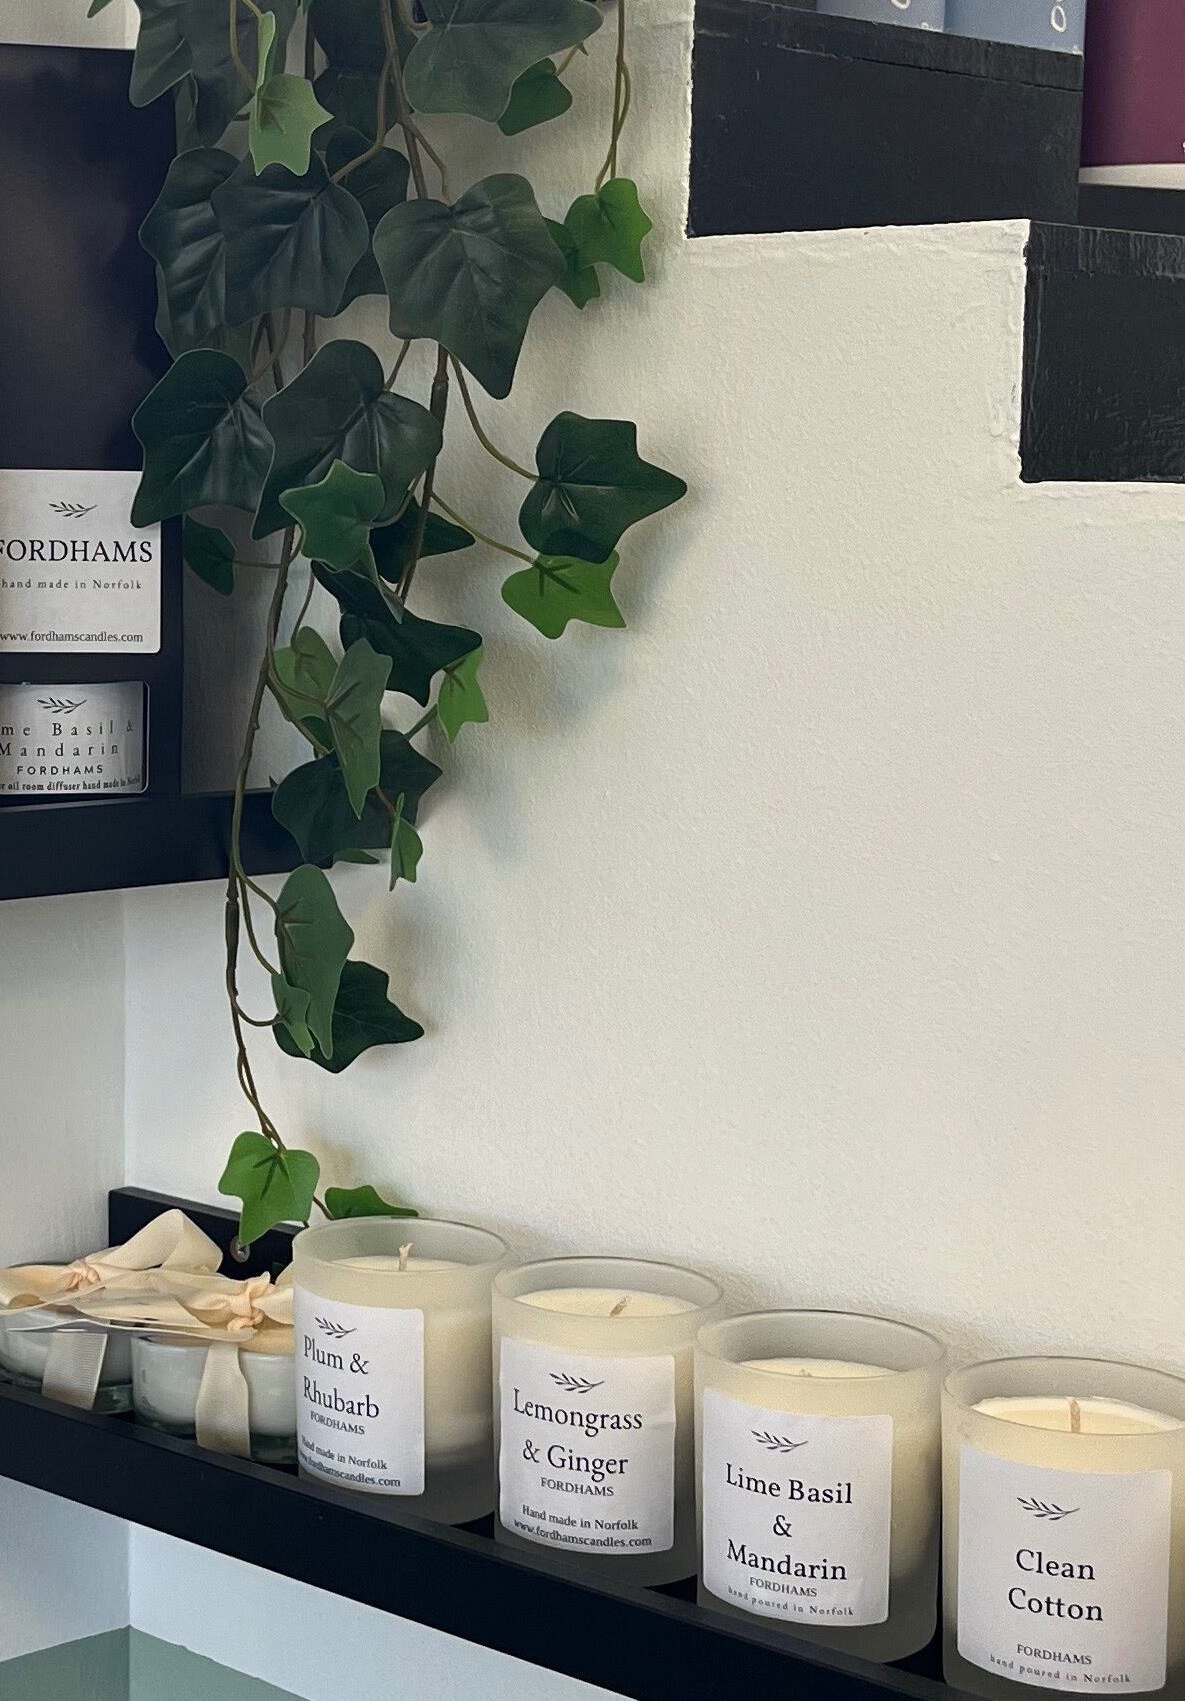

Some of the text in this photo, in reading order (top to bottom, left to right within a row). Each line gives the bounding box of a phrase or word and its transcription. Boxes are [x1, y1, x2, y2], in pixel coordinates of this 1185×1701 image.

[1, 579, 143, 590] hand made in Norfolk
[0, 631, 144, 643] www.fordhamscandles.com
[52, 720, 114, 736] Basil
[126, 721, 134, 733] &
[17, 765, 103, 775] FORDHAMS
[22, 782, 44, 791] room
[46, 781, 80, 791] diffuser
[82, 780, 101, 790] hand
[304, 1335, 369, 1375] Plum &
[304, 1375, 380, 1418] Rhubarb
[310, 1410, 365, 1435] FORDHAMS
[513, 1387, 643, 1438] Lemongrass
[316, 1446, 335, 1460] made
[337, 1453, 346, 1463] in
[348, 1455, 388, 1470] Norfolk
[522, 1439, 629, 1482] & Ginger
[540, 1477, 614, 1497] FORDHAMS
[726, 1463, 853, 1504] Lime Basil
[522, 1505, 638, 1531] Hand made in Norfolk
[772, 1514, 793, 1538] &
[514, 1519, 652, 1547] www.fordhamscandles.com
[727, 1538, 847, 1580] Mandarin
[1016, 1548, 1095, 1580] Clean
[749, 1576, 818, 1597] FORDHAMS
[728, 1585, 854, 1616] hand poured in Norfolk
[1008, 1587, 1104, 1621] Cotton
[1017, 1644, 1092, 1665] FORDHAMS
[990, 1653, 1131, 1683] hand poured in Norfolk
